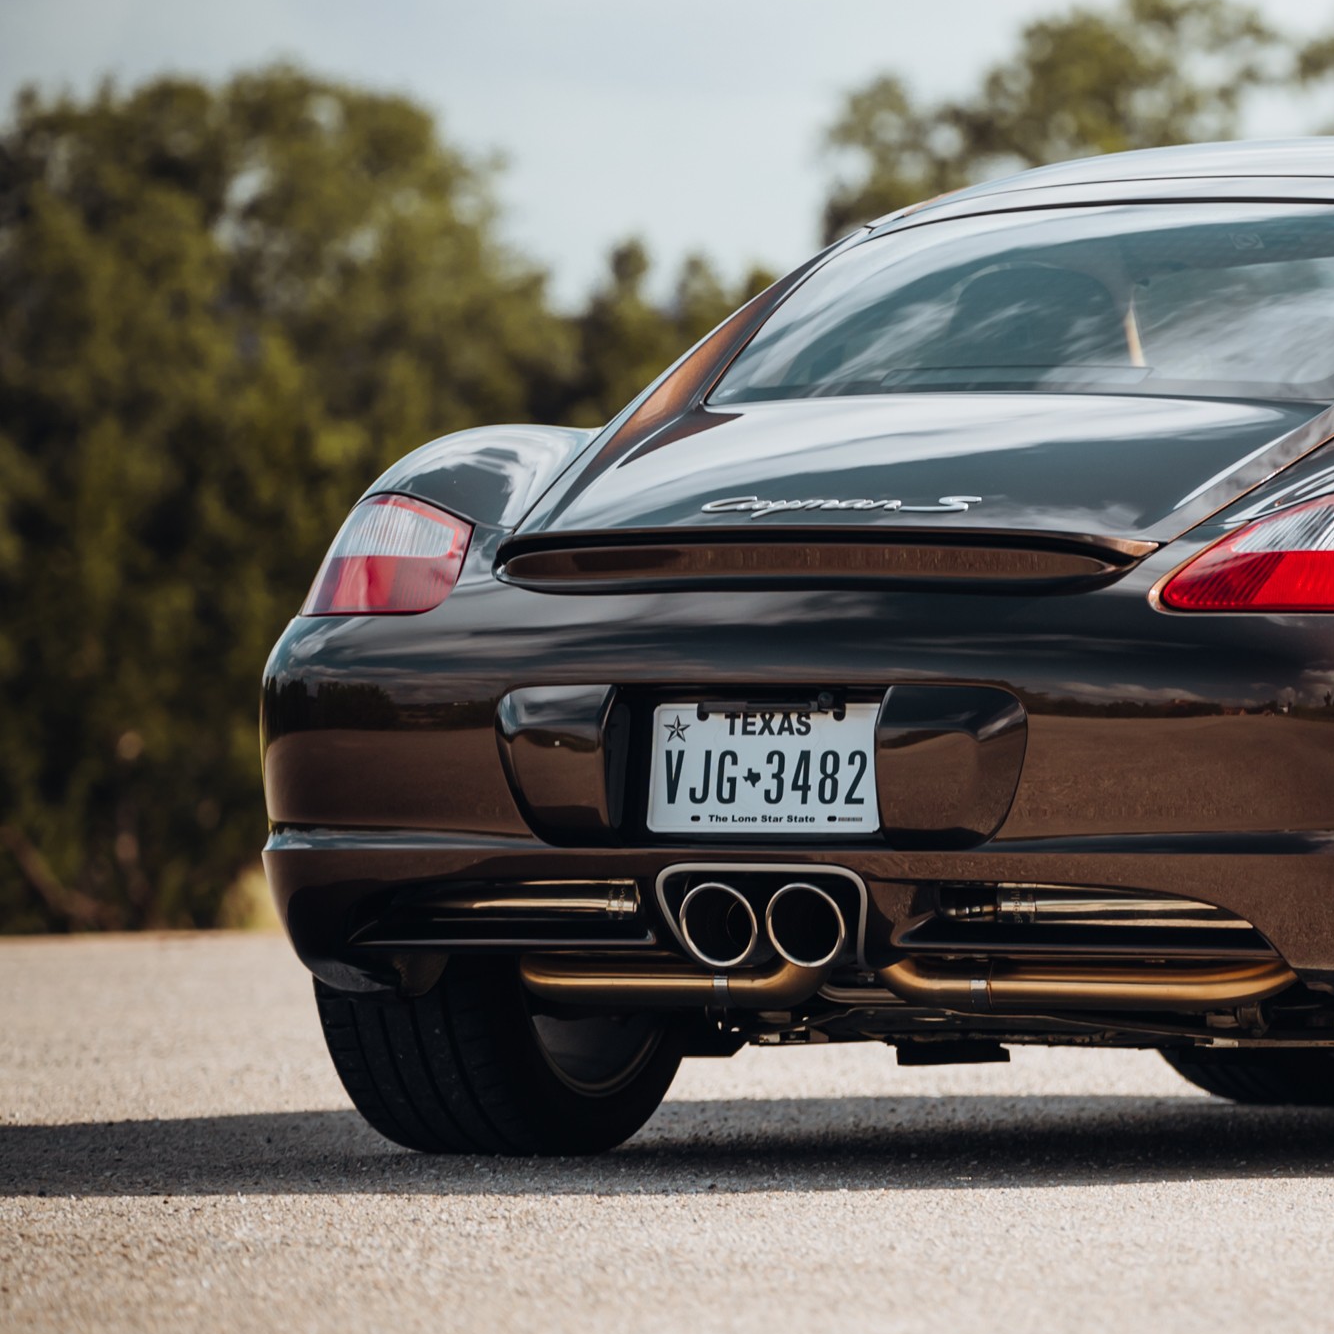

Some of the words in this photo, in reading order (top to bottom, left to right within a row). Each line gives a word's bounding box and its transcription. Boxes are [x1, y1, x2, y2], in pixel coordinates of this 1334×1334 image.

[701, 496, 901, 519] Cayman
[899, 495, 982, 512] S
[724, 712, 811, 735] TEXAS
[708, 814, 728, 823] The
[731, 814, 757, 823] Lone
[761, 814, 784, 823] Star
[787, 814, 816, 823] State
